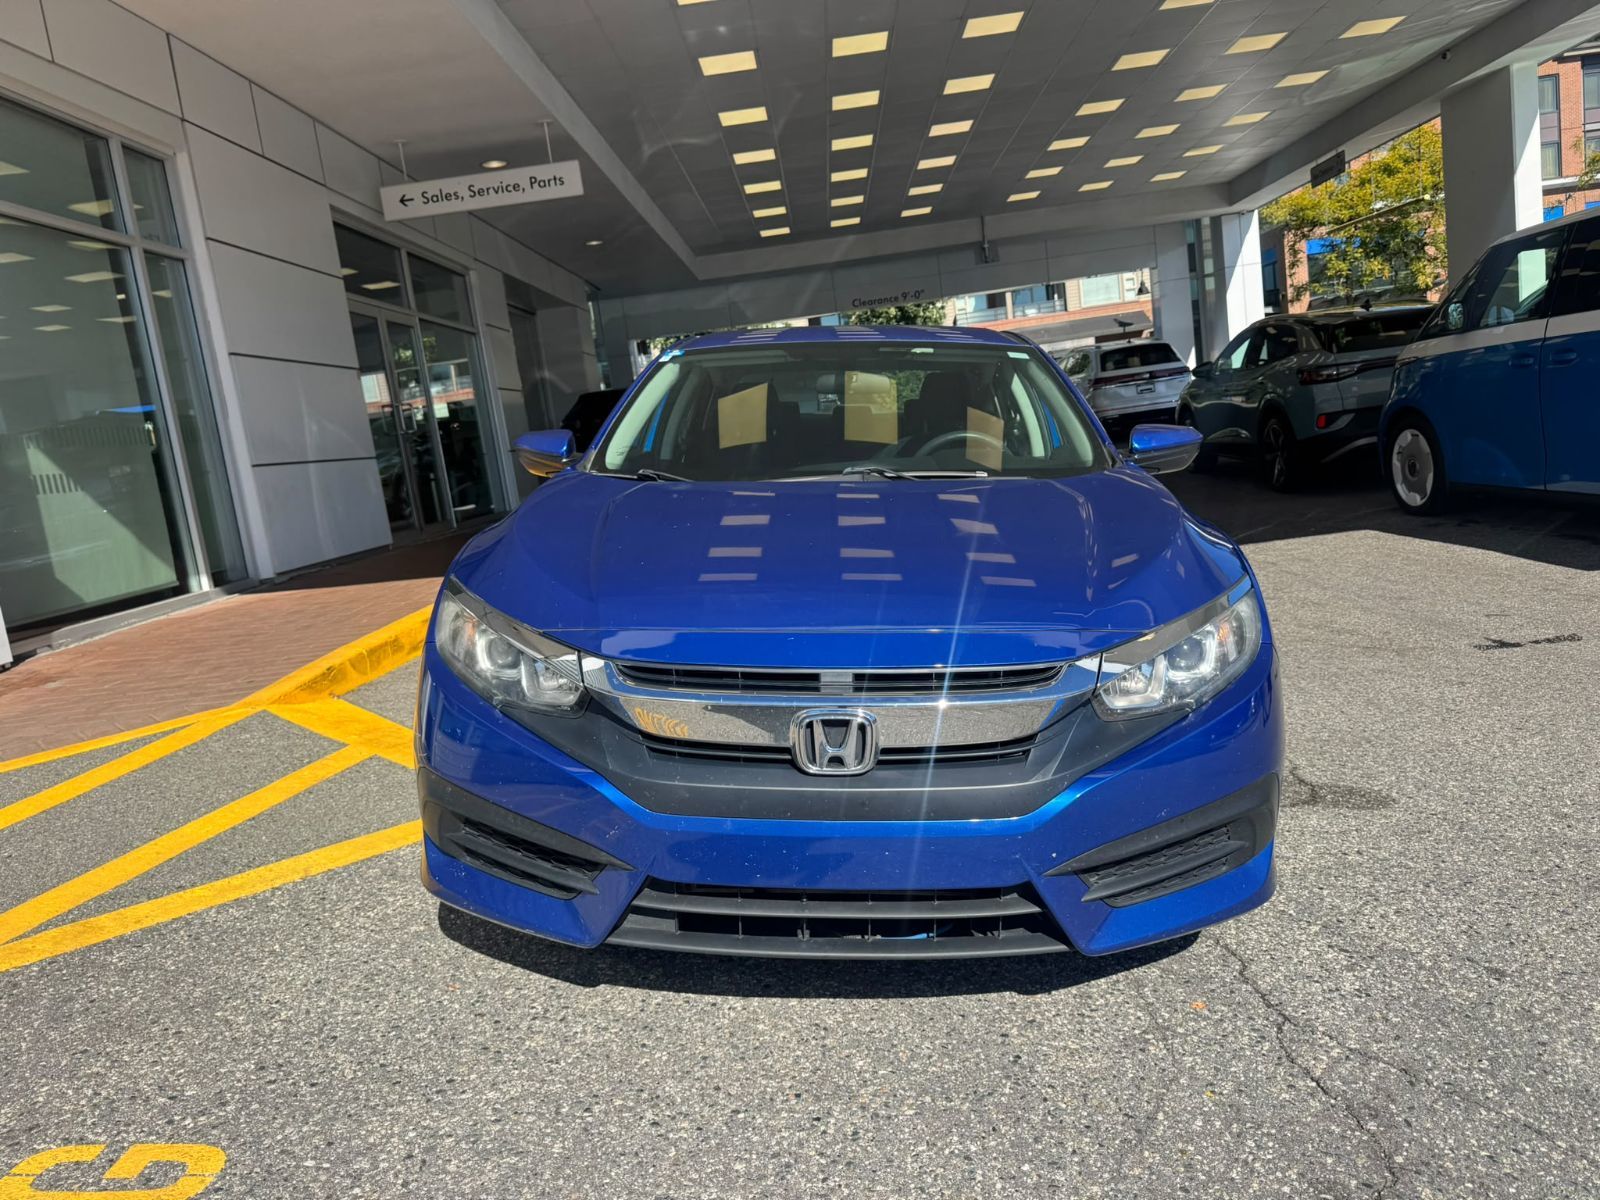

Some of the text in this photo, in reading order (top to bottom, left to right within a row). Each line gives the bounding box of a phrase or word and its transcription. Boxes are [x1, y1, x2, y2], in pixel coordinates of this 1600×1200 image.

[421, 174, 565, 205] Sales, Service, Parts
[851, 296, 899, 308] Clearance
